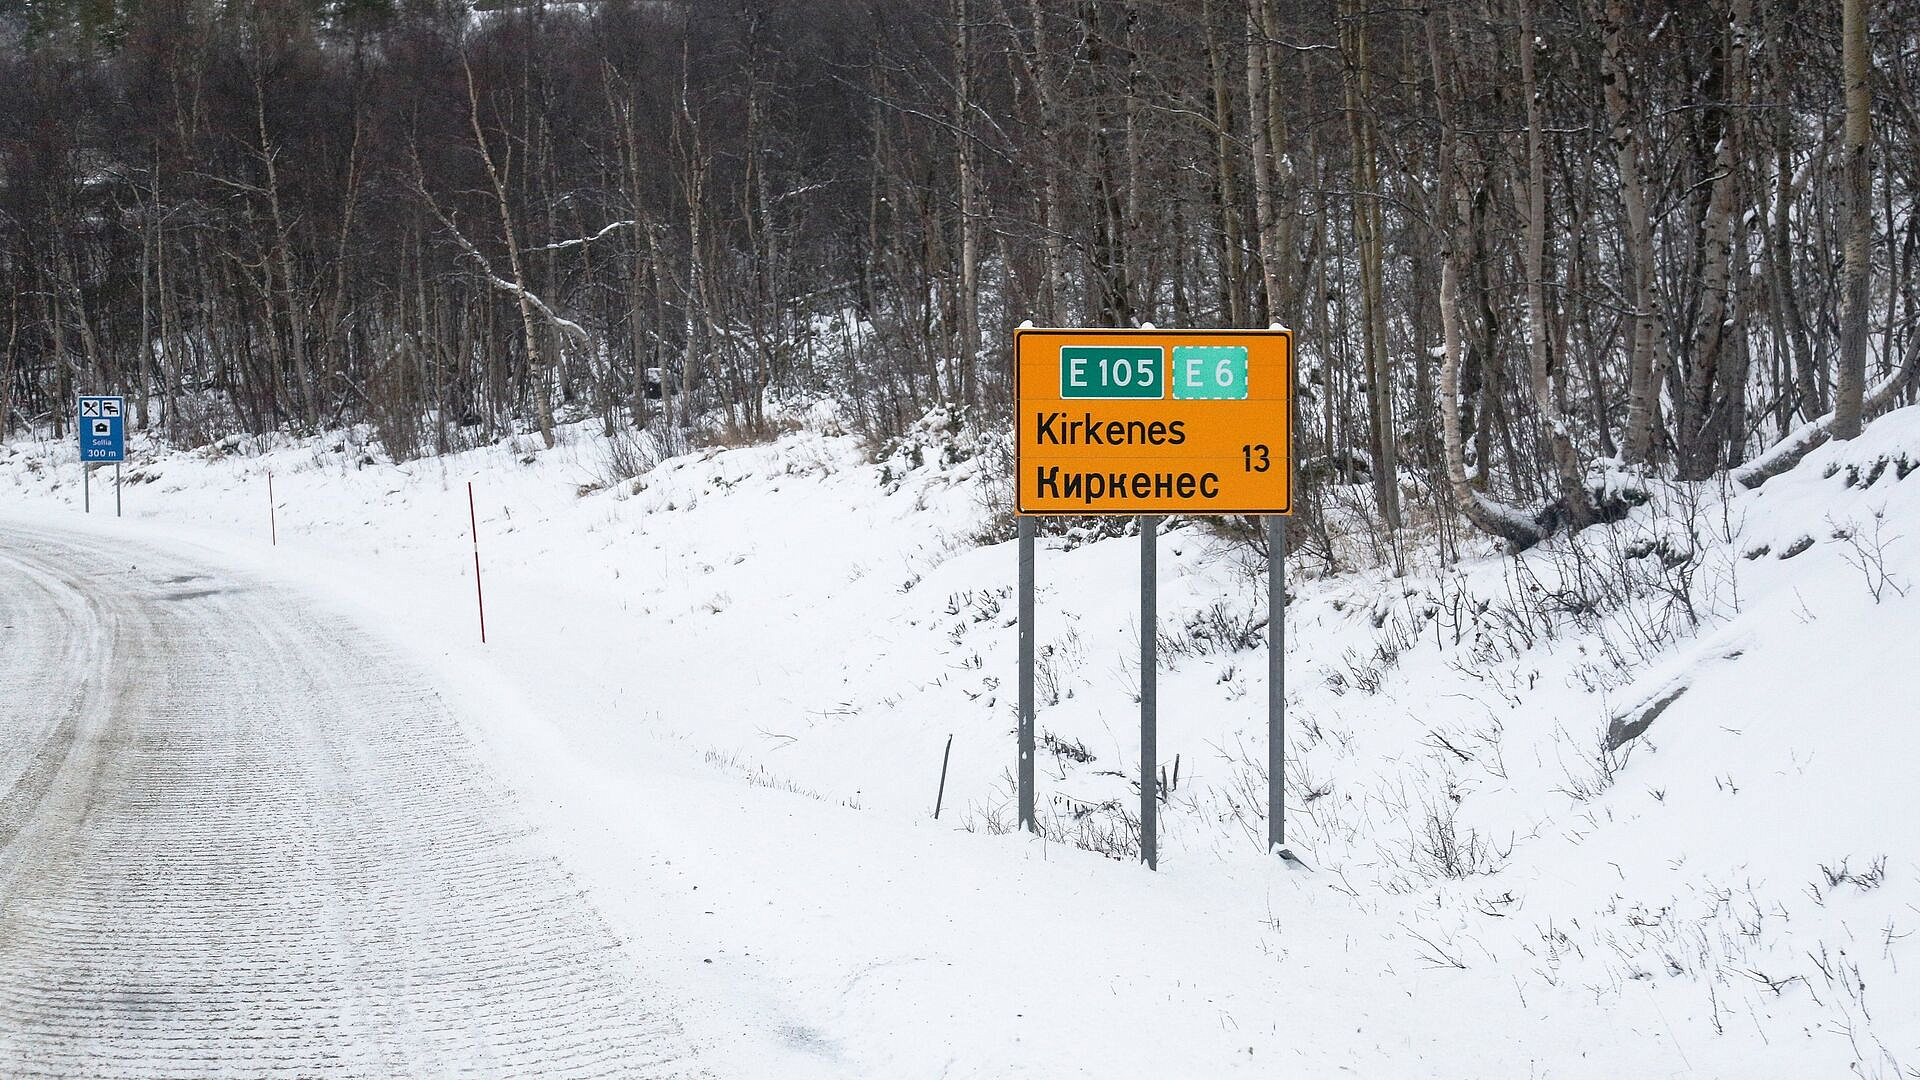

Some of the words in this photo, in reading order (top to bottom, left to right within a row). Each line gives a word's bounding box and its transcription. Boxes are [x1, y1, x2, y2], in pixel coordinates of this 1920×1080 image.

[1070, 359, 1087, 386] E
[1099, 359, 1154, 386] 105
[1186, 359, 1203, 387] E
[1215, 359, 1234, 387] 6
[1037, 412, 1186, 445] Kirkenes
[1242, 444, 1271, 472] 13
[1037, 466, 1220, 504] Киркенес
